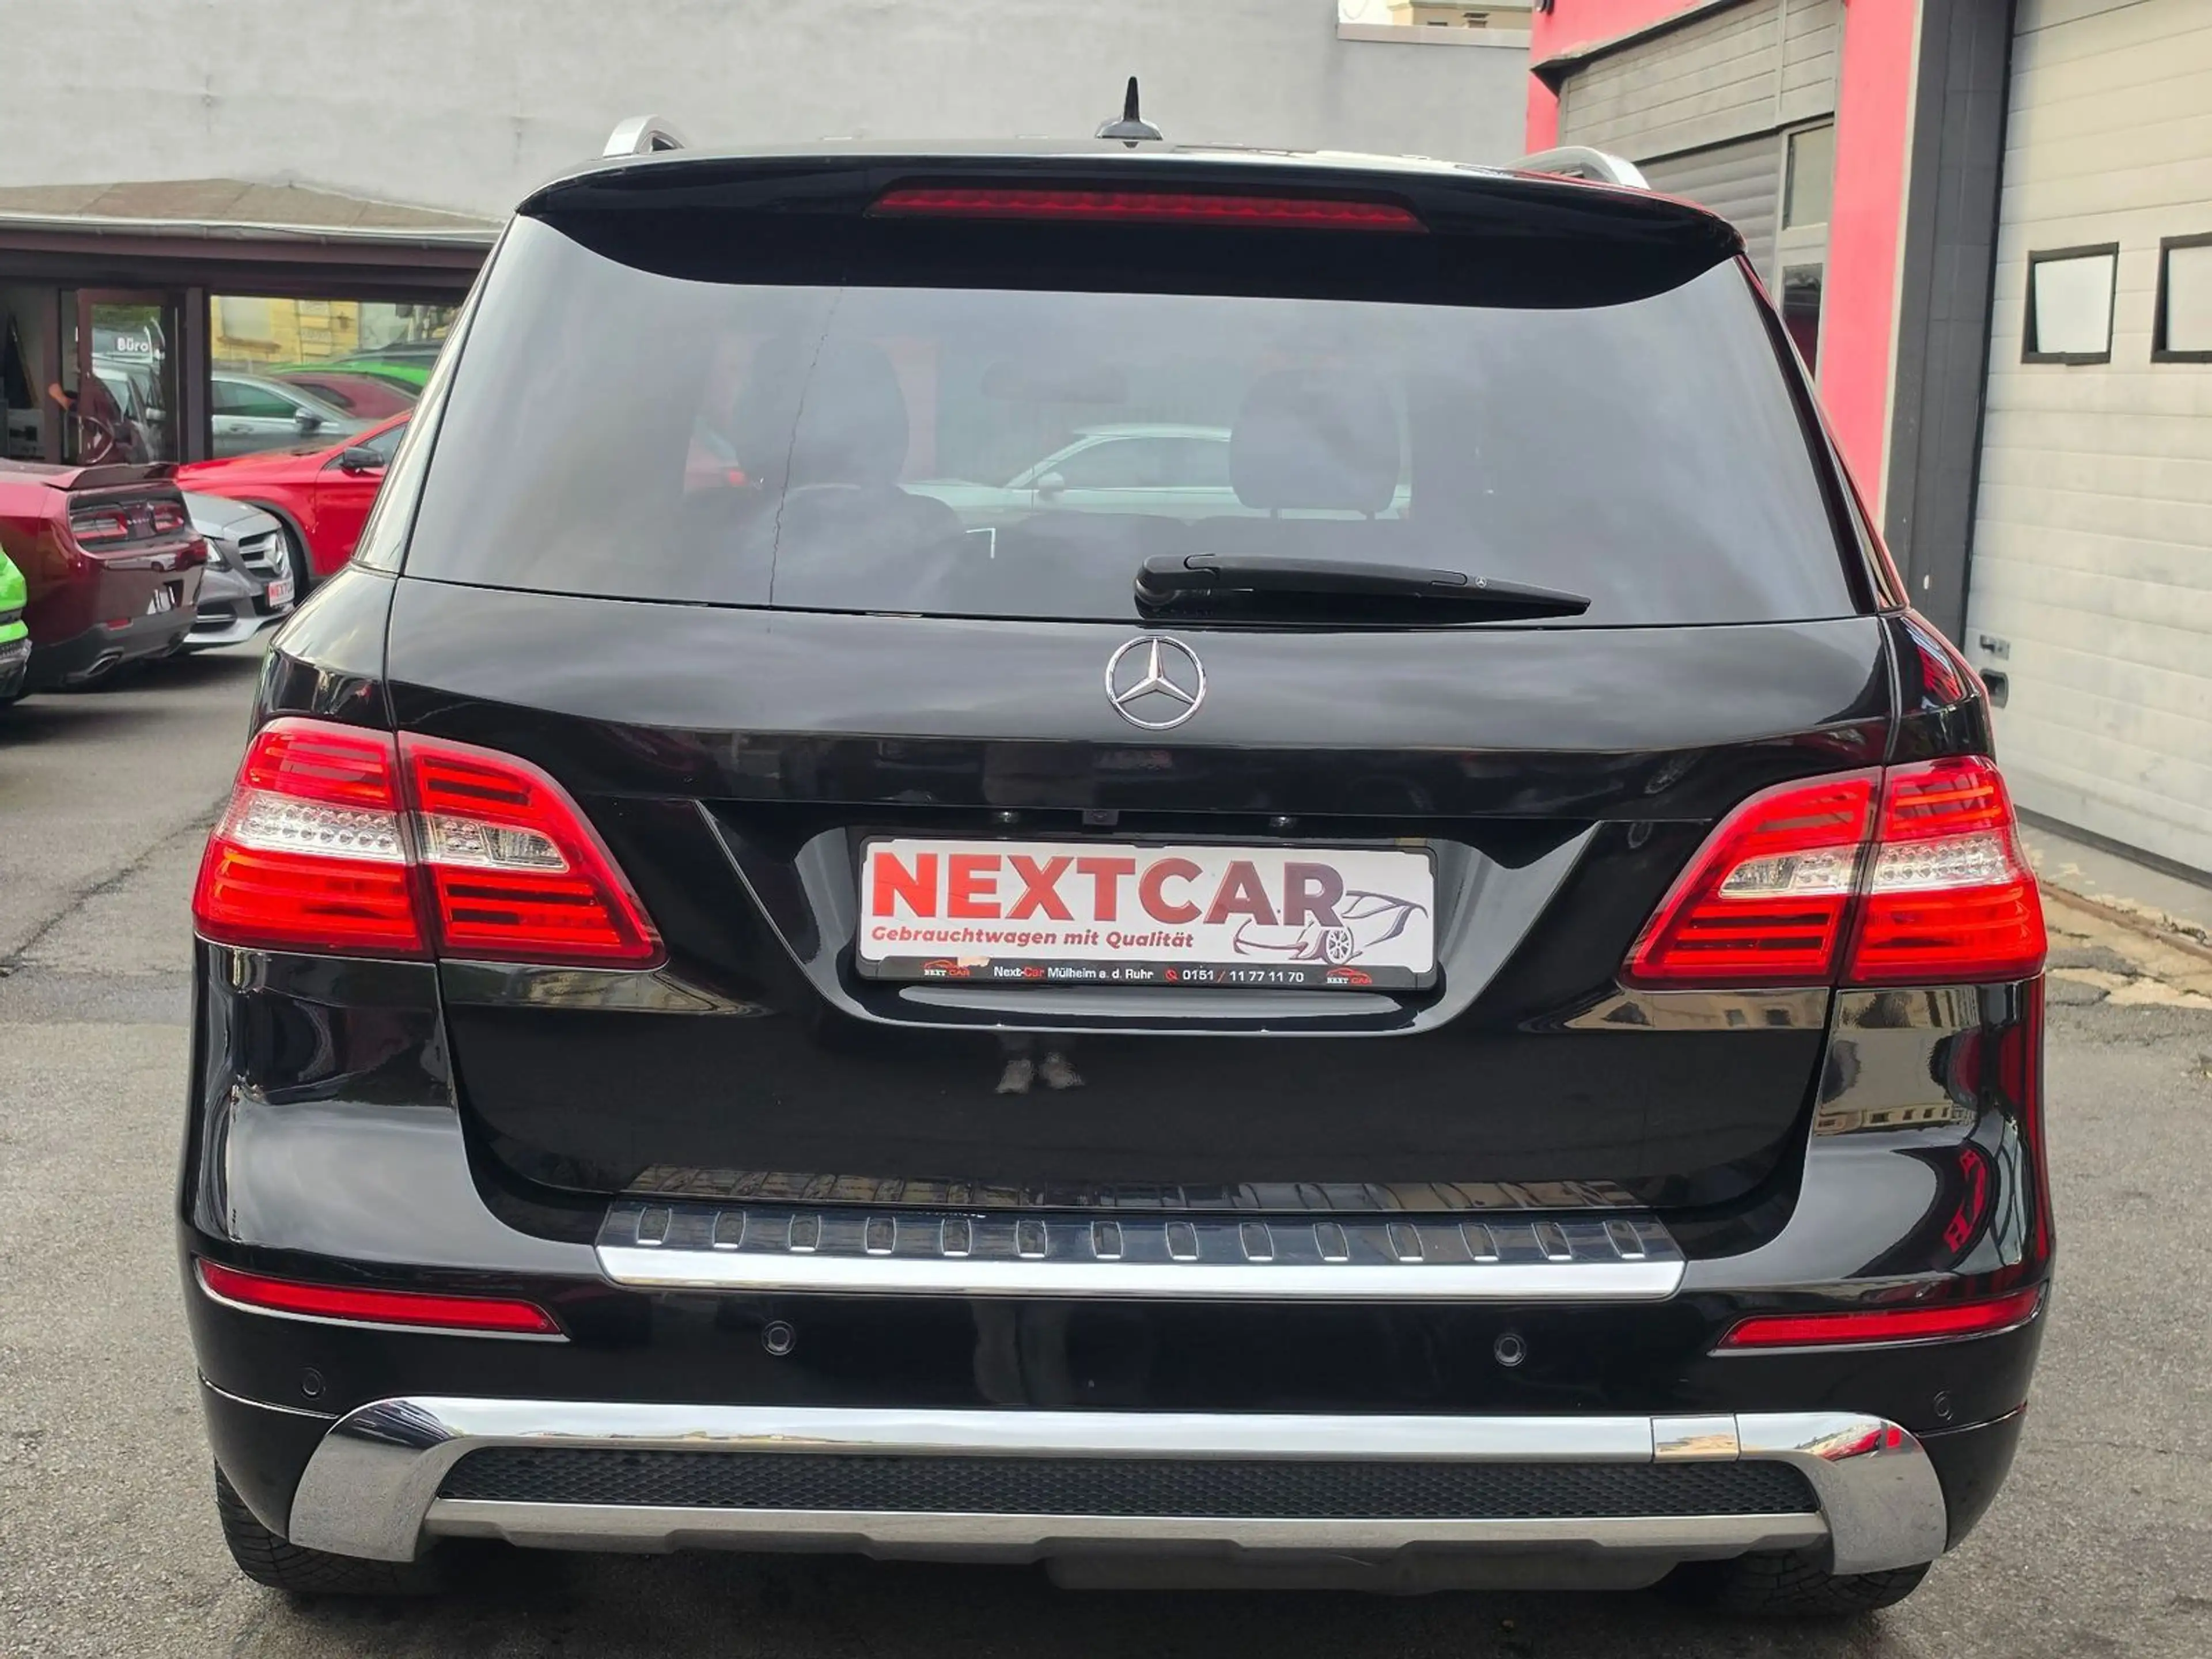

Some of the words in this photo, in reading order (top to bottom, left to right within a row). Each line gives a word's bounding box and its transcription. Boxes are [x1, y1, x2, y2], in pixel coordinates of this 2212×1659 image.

[117, 336, 149, 353] Büro
[872, 853, 1343, 926] NEXTCAR
[871, 926, 1056, 946] Gebrauchtwagen
[1063, 929, 1099, 945] mit
[1106, 931, 1194, 949] Qualität
[994, 966, 1045, 976] Next-Car
[1048, 967, 1096, 978] Mülheim
[1099, 970, 1109, 978] a.
[1112, 969, 1122, 979] d.
[1126, 969, 1154, 979] Ruhr
[1183, 969, 1213, 980] 0151
[1230, 971, 1244, 982] 11
[1248, 972, 1265, 982] 77
[1268, 972, 1283, 982] 11
[1288, 972, 1304, 982] 70
